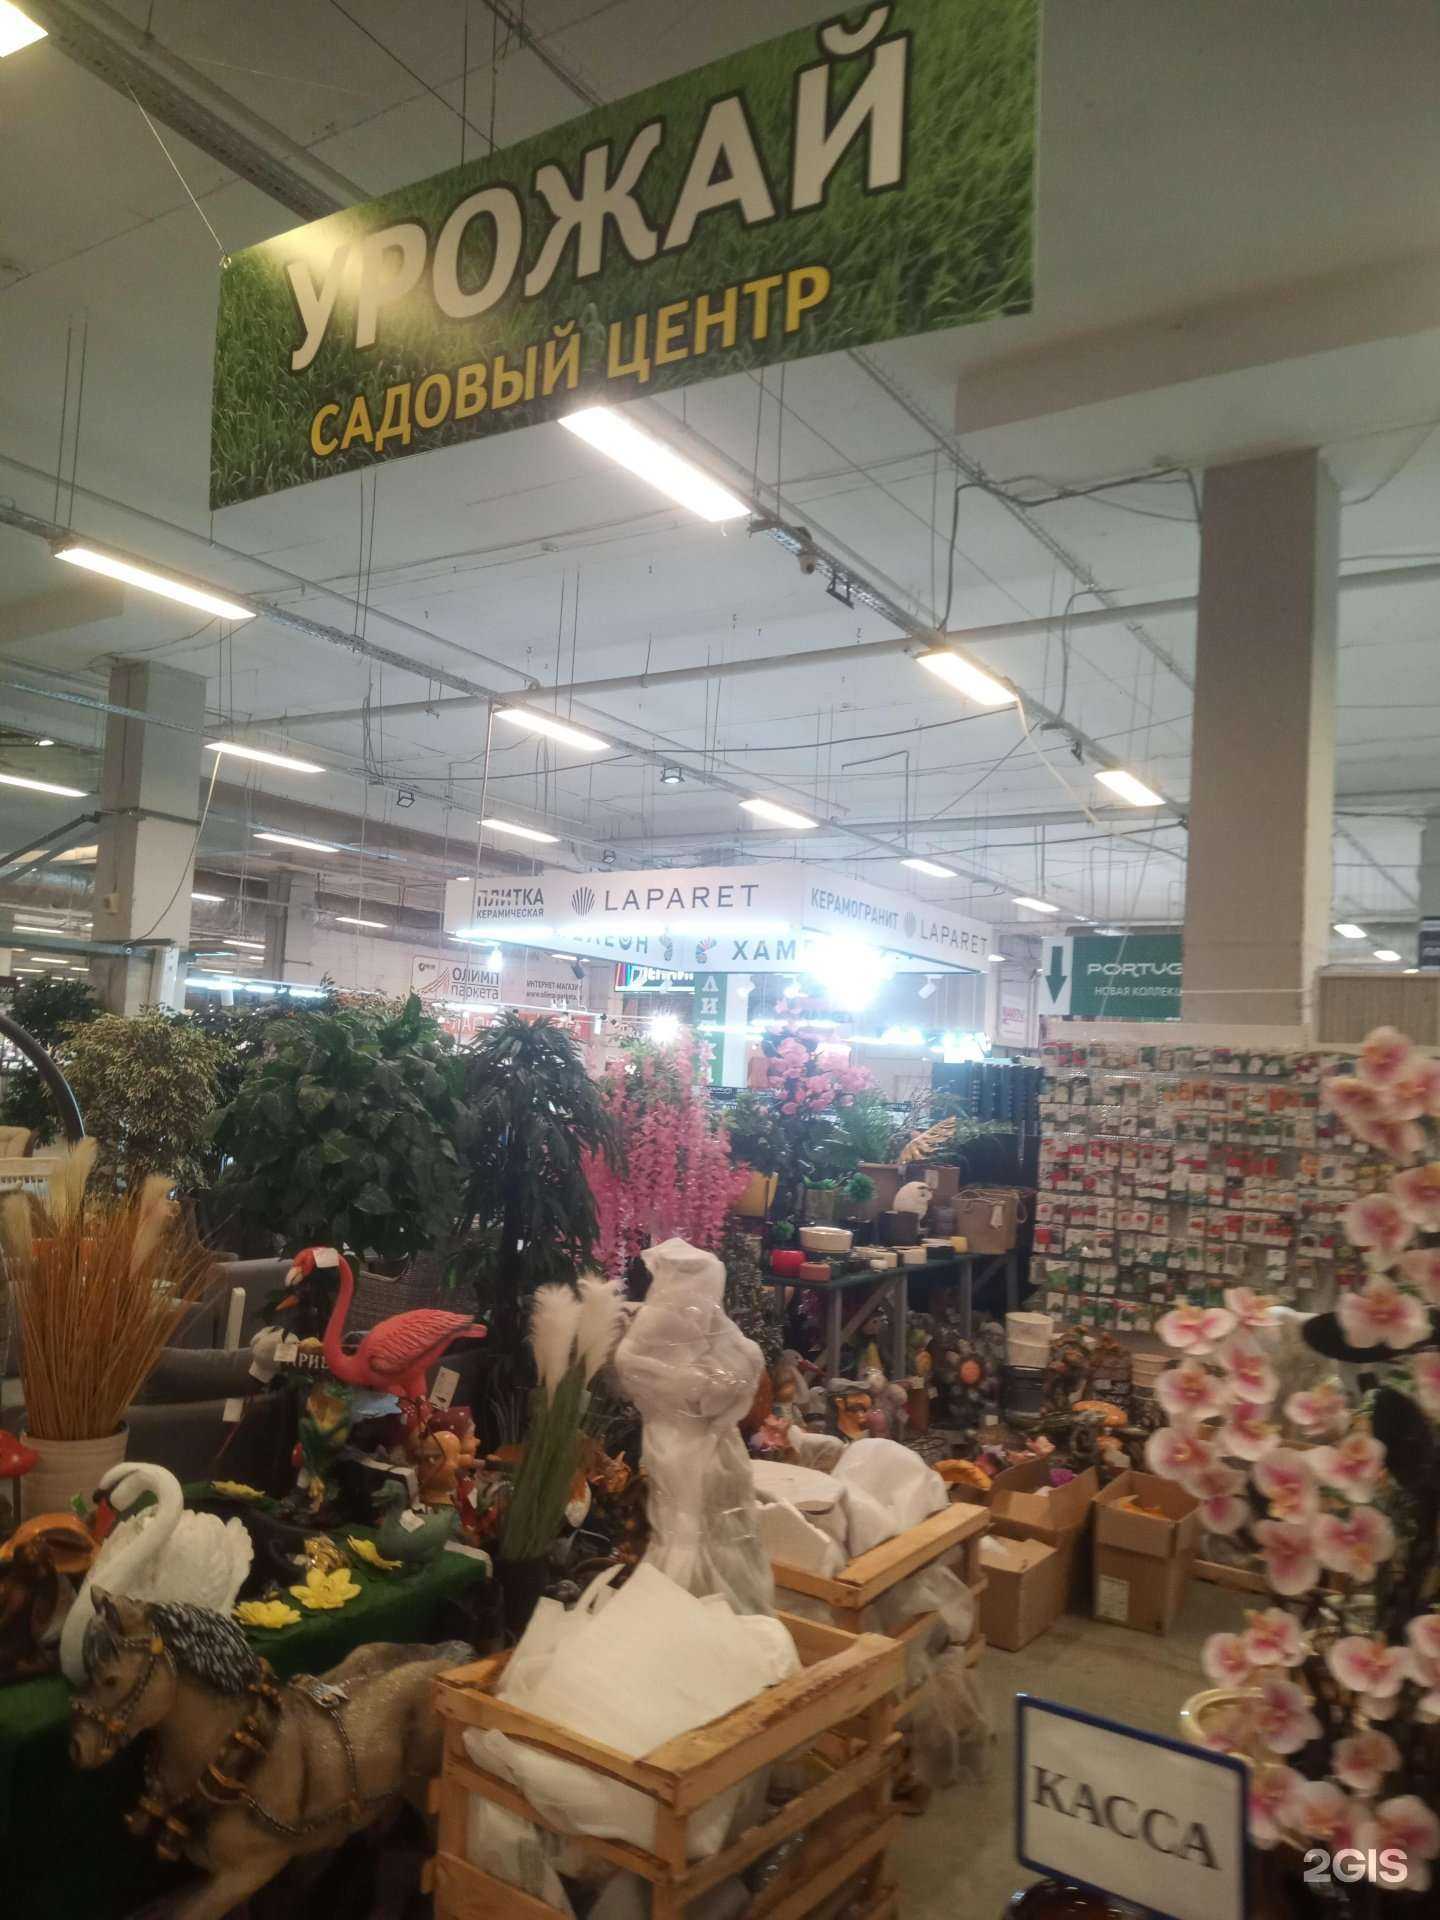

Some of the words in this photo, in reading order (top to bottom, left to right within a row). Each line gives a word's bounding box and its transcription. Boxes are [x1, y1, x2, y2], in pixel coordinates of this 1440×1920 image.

[286, 6, 910, 372] УРОЖАЙ
[309, 323, 582, 457] САДОВЫЙ
[607, 265, 831, 383] ЦЕНТР
[476, 908, 544, 920] КЕРАМИЧЕСКАЯ
[477, 887, 544, 907] ПЛИТКА
[604, 884, 759, 912] LAPARET
[811, 887, 899, 930] КЕРАМОГРАНИТ
[920, 919, 988, 956] LAPARET
[1095, 986, 1130, 997] НОВАЯ
[1031, 1764, 1222, 1871] КАССА
